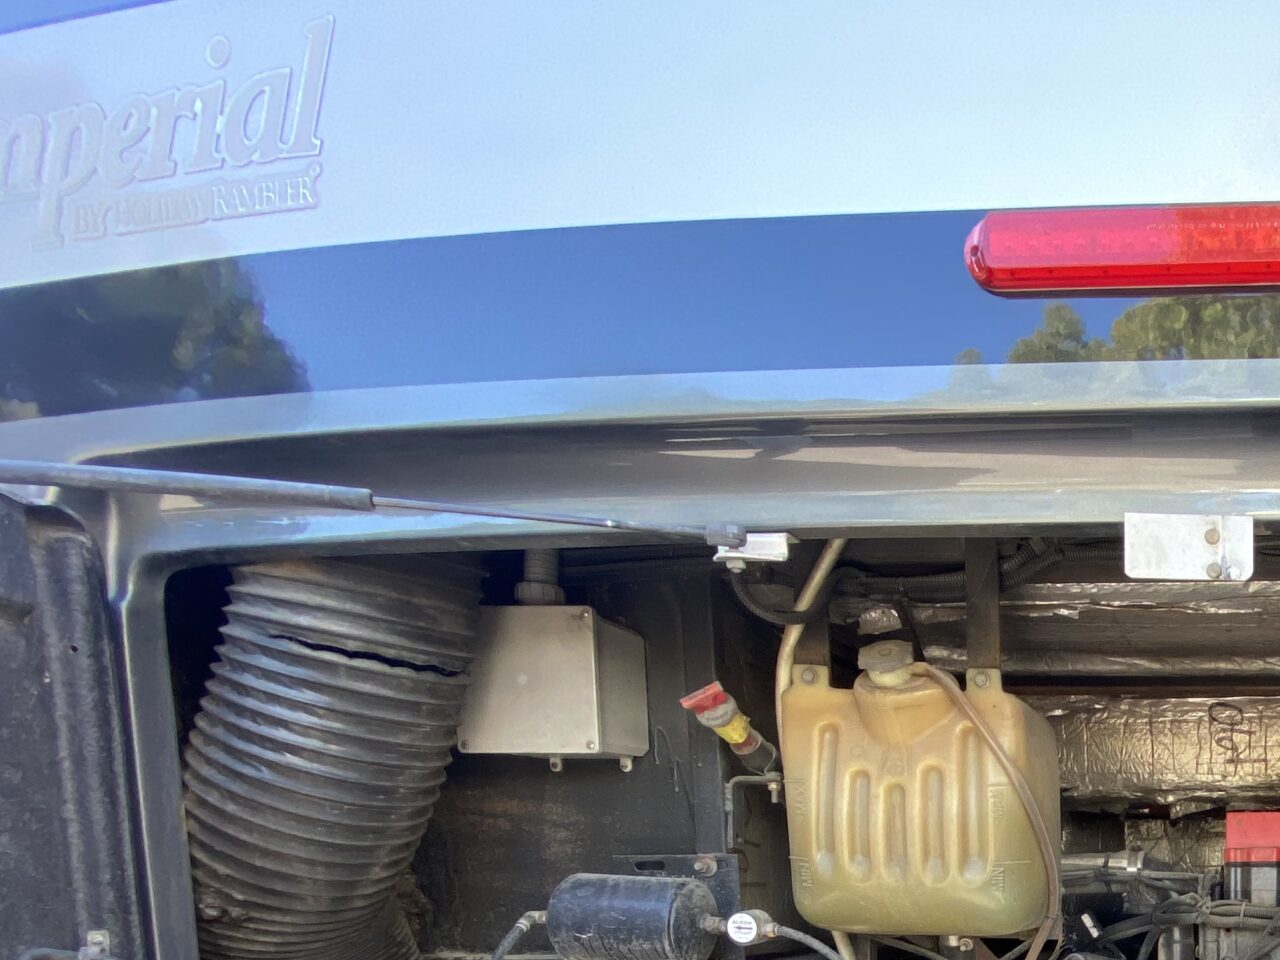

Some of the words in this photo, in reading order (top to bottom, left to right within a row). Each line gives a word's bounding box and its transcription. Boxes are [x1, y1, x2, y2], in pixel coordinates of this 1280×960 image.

[74, 203, 105, 234] BY
[211, 176, 315, 215] RAMBLER
[800, 862, 813, 887] MIN
